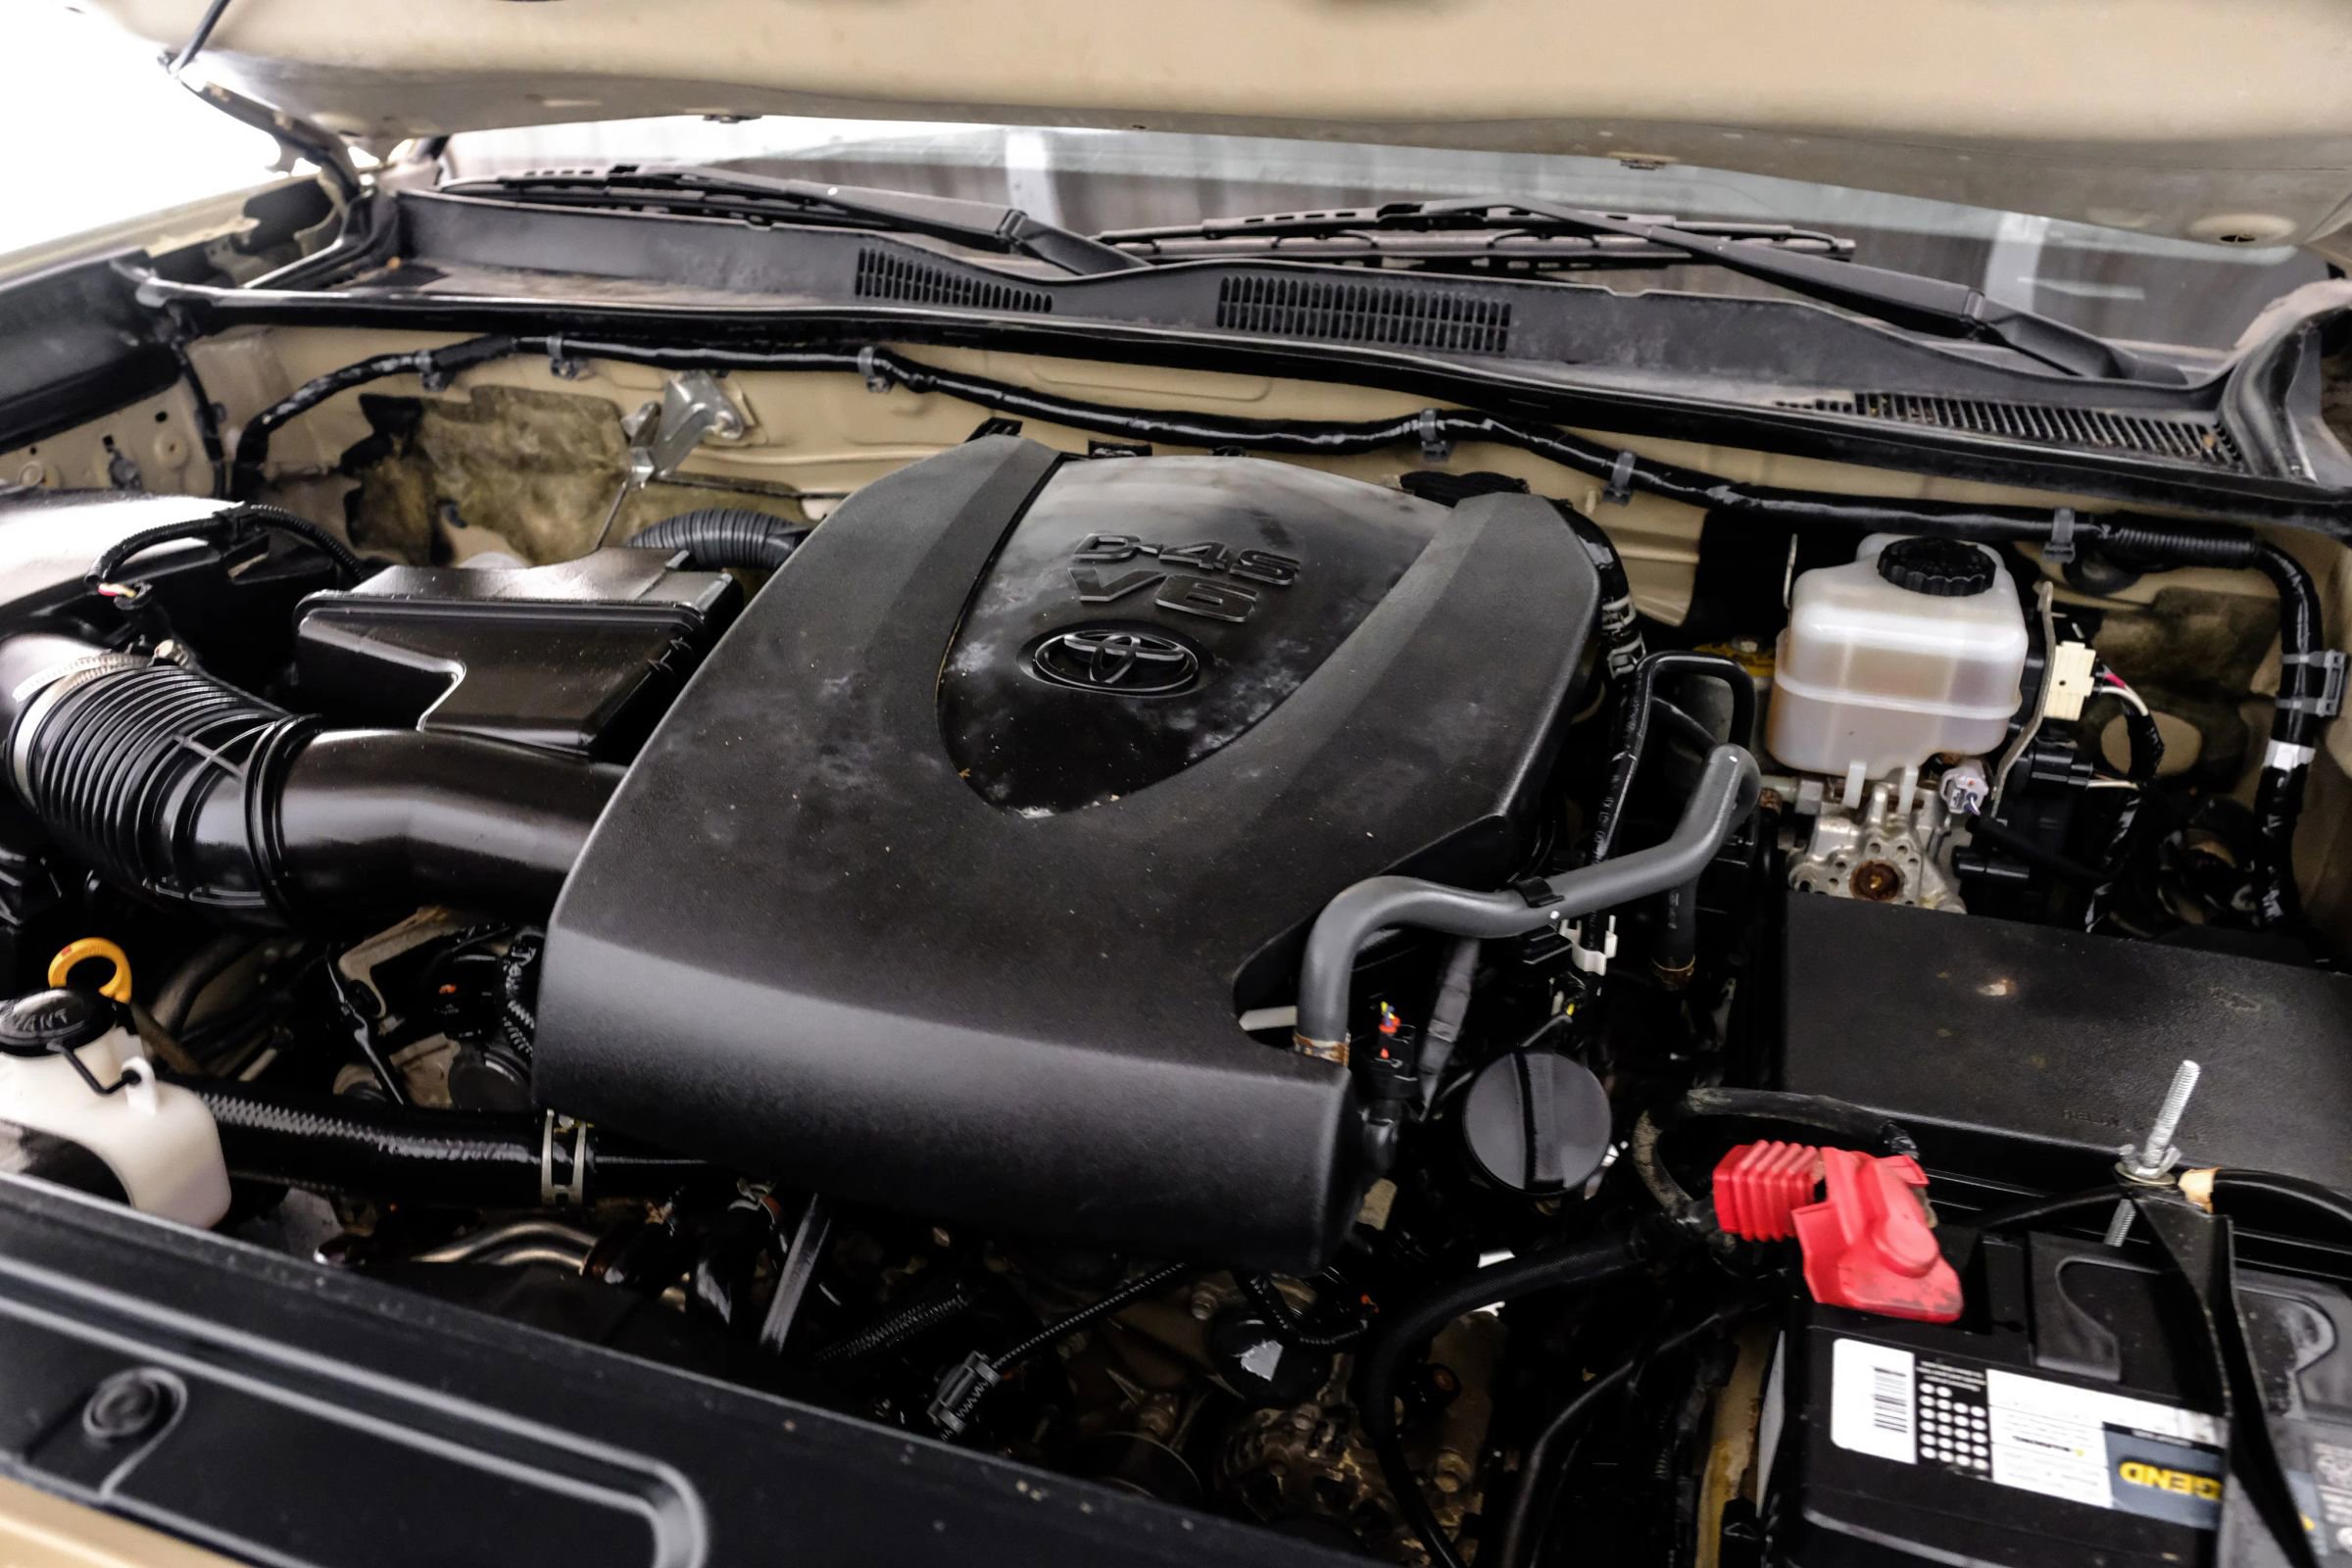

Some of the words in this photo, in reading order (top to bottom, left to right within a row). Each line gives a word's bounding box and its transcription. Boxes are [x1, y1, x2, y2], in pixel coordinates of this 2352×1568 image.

[1073, 532, 1302, 586] D-4S
[1066, 566, 1259, 622] V6
[2119, 1460, 2223, 1501] GEND
